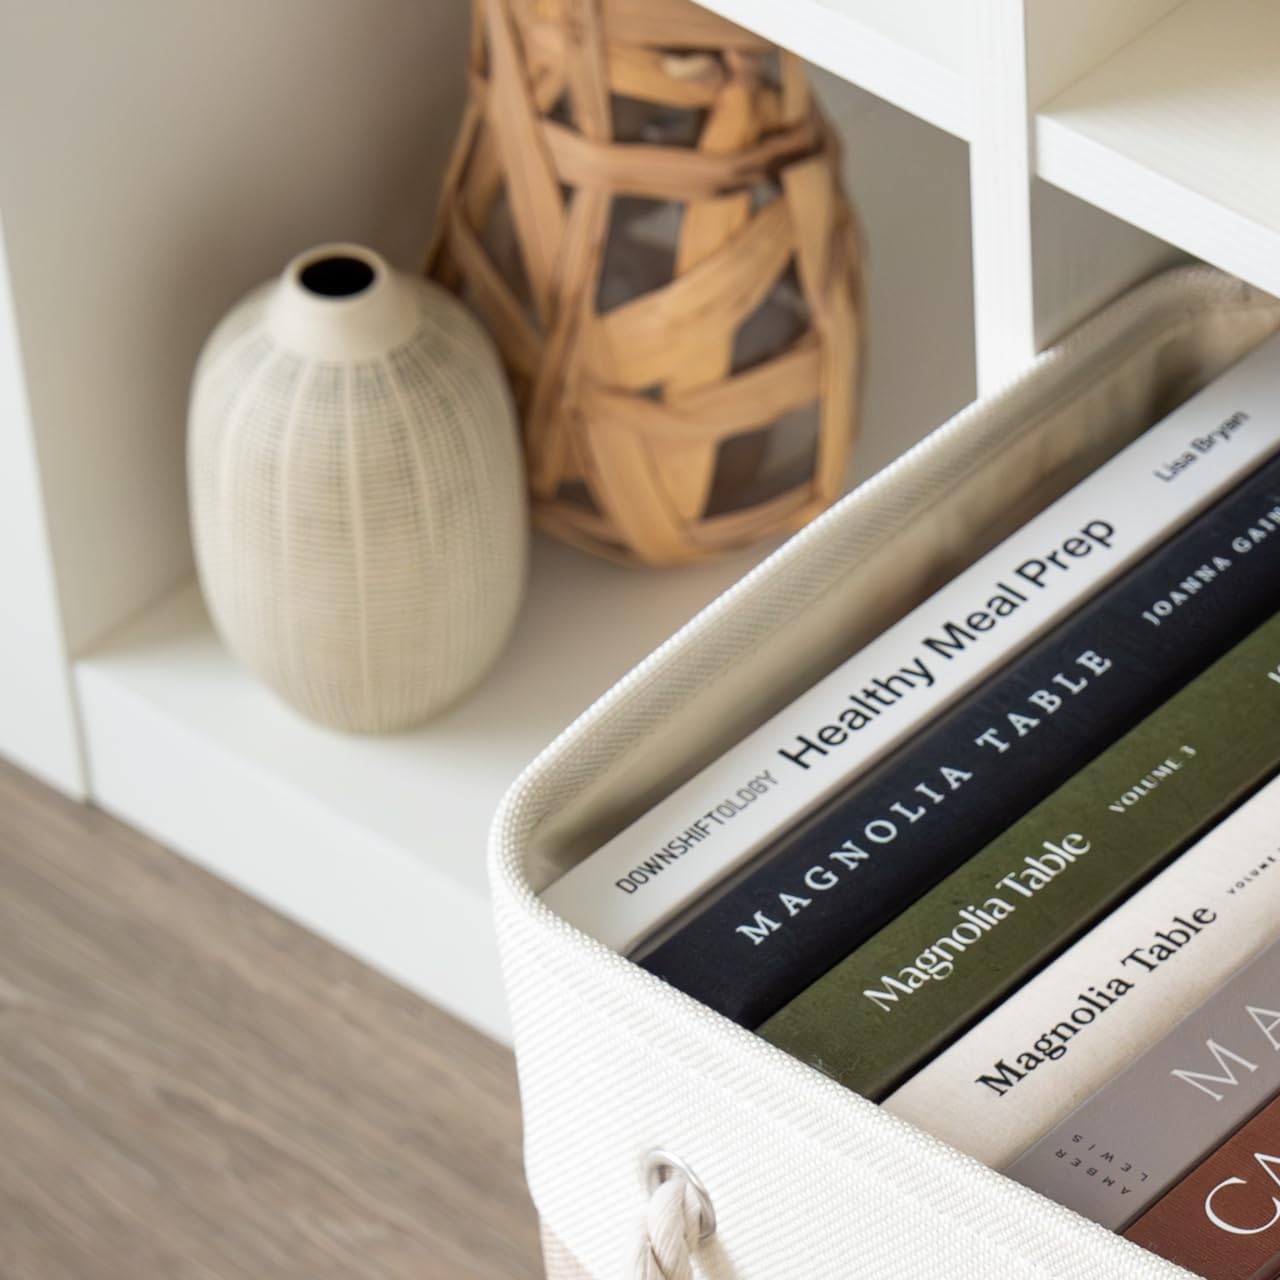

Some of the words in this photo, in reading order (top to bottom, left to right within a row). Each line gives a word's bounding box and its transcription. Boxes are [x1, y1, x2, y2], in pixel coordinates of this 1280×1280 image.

[1154, 451, 1199, 483] Lisa
[1190, 410, 1251, 454] Bryan
[1142, 556, 1232, 626] JOANNA
[778, 658, 935, 770] Healthy
[922, 583, 1028, 659] Meal
[1015, 519, 1115, 588] Prep
[735, 764, 973, 945] MAGNOLIA
[975, 649, 1112, 753] TABLE
[1108, 757, 1183, 813] VOLUME
[1179, 745, 1197, 758] 3
[615, 770, 778, 894] DOWNSHIFTOLOGY
[1226, 856, 1276, 894] VOLUME
[863, 897, 1015, 1012] Magnolia
[995, 832, 1091, 898] Table
[974, 978, 1135, 1097] Magnolia
[1120, 907, 1217, 973] Table
[1055, 1149, 1132, 1195] AMBER
[1072, 1134, 1149, 1181] LEWIS
